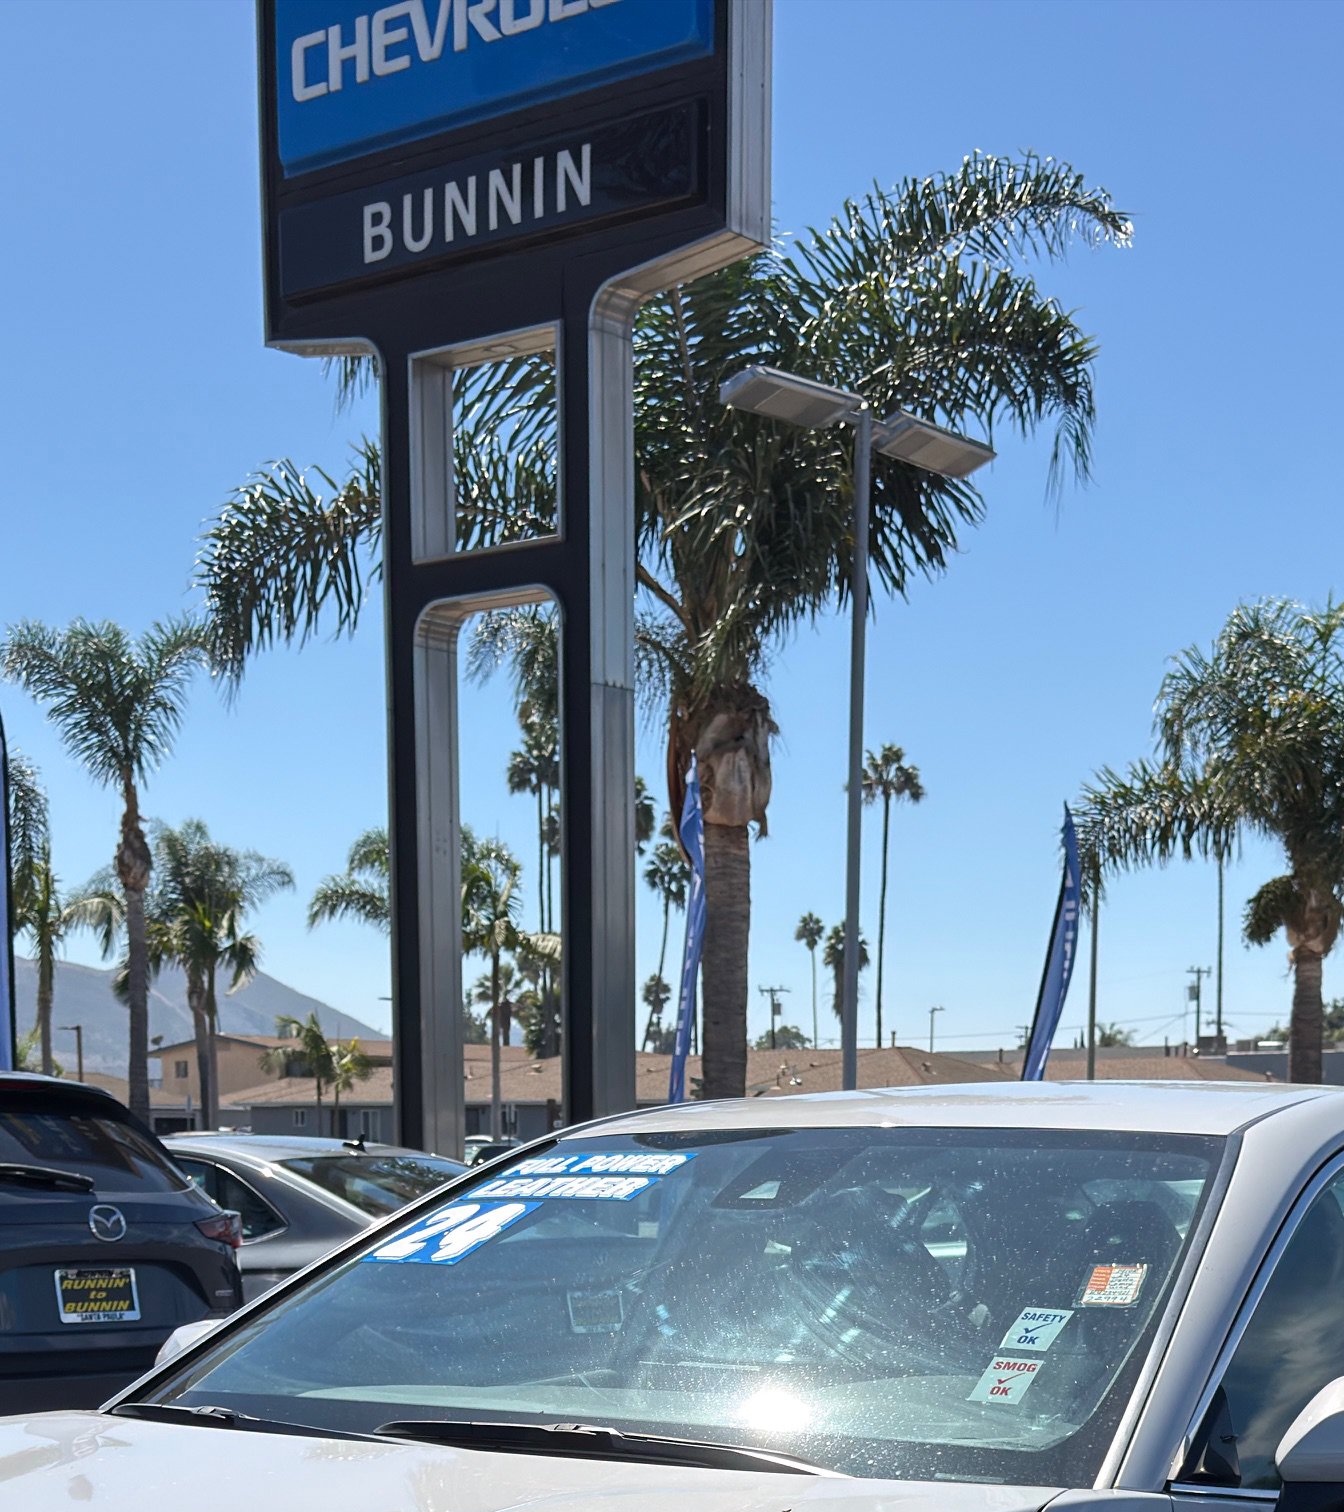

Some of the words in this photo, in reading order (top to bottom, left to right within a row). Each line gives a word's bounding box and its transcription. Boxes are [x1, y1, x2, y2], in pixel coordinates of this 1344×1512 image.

[361, 143, 593, 265] BUNNIN
[509, 1154, 571, 1177] FULL
[574, 1153, 689, 1175] POWER
[476, 1176, 651, 1200] LEATHER
[372, 1202, 527, 1262] 24
[62, 1278, 130, 1290] RUNNIN'
[89, 1290, 107, 1299] to
[64, 1300, 130, 1313] BUNNIN
[1021, 1312, 1067, 1324] SAFETY
[1017, 1335, 1040, 1345] OK
[993, 1361, 1039, 1373] SMOG
[989, 1386, 1013, 1397] OK
